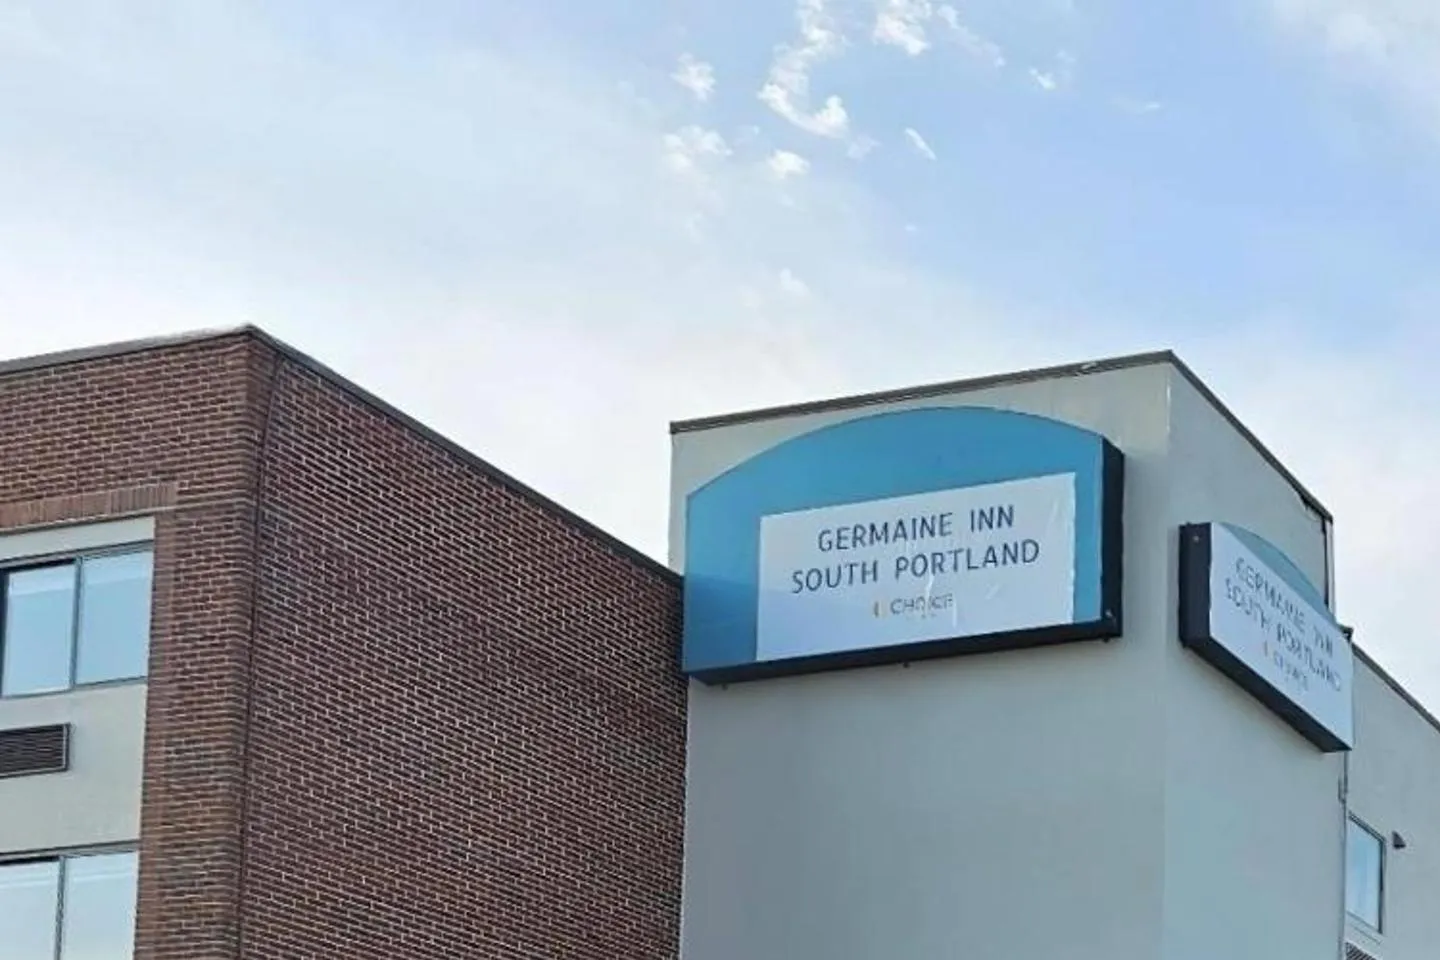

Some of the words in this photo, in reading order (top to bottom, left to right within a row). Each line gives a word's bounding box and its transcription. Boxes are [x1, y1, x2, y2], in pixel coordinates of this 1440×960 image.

[818, 512, 953, 552] GERMAINE
[970, 504, 1014, 533] INN
[791, 559, 879, 594] SOUTH
[895, 538, 1040, 581] PORTLAND
